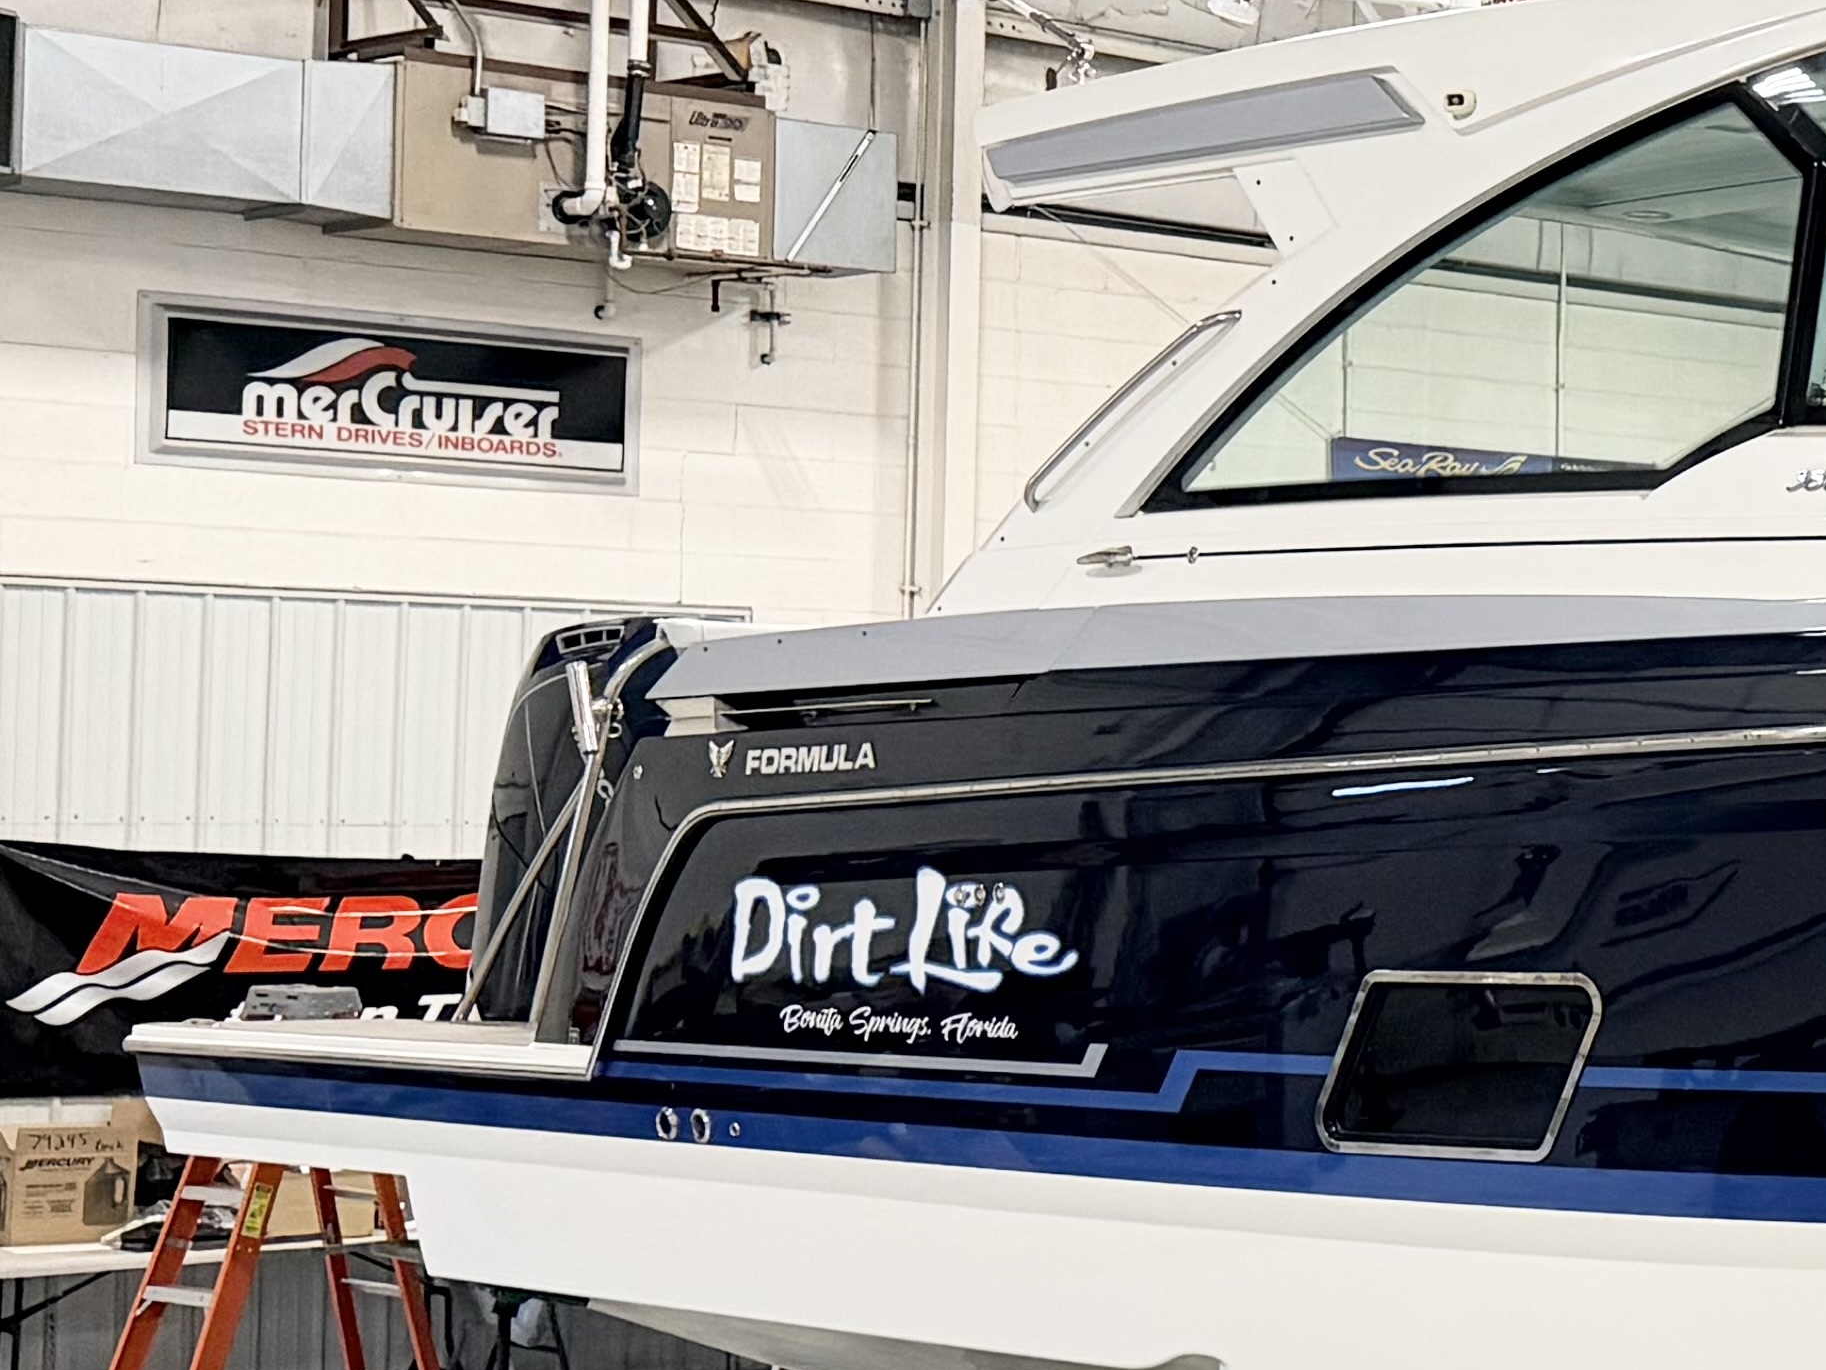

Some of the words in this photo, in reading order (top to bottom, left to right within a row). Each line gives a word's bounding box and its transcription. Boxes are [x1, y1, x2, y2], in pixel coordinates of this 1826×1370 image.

[243, 419, 324, 440] STERN
[1355, 447, 1422, 475] Sea
[744, 742, 876, 776] FORMULA
[76, 892, 478, 974] MERC
[731, 876, 896, 987] Dirt
[889, 866, 1080, 996] Life
[779, 1004, 844, 1037] Bonita
[940, 1012, 1019, 1044] Florida
